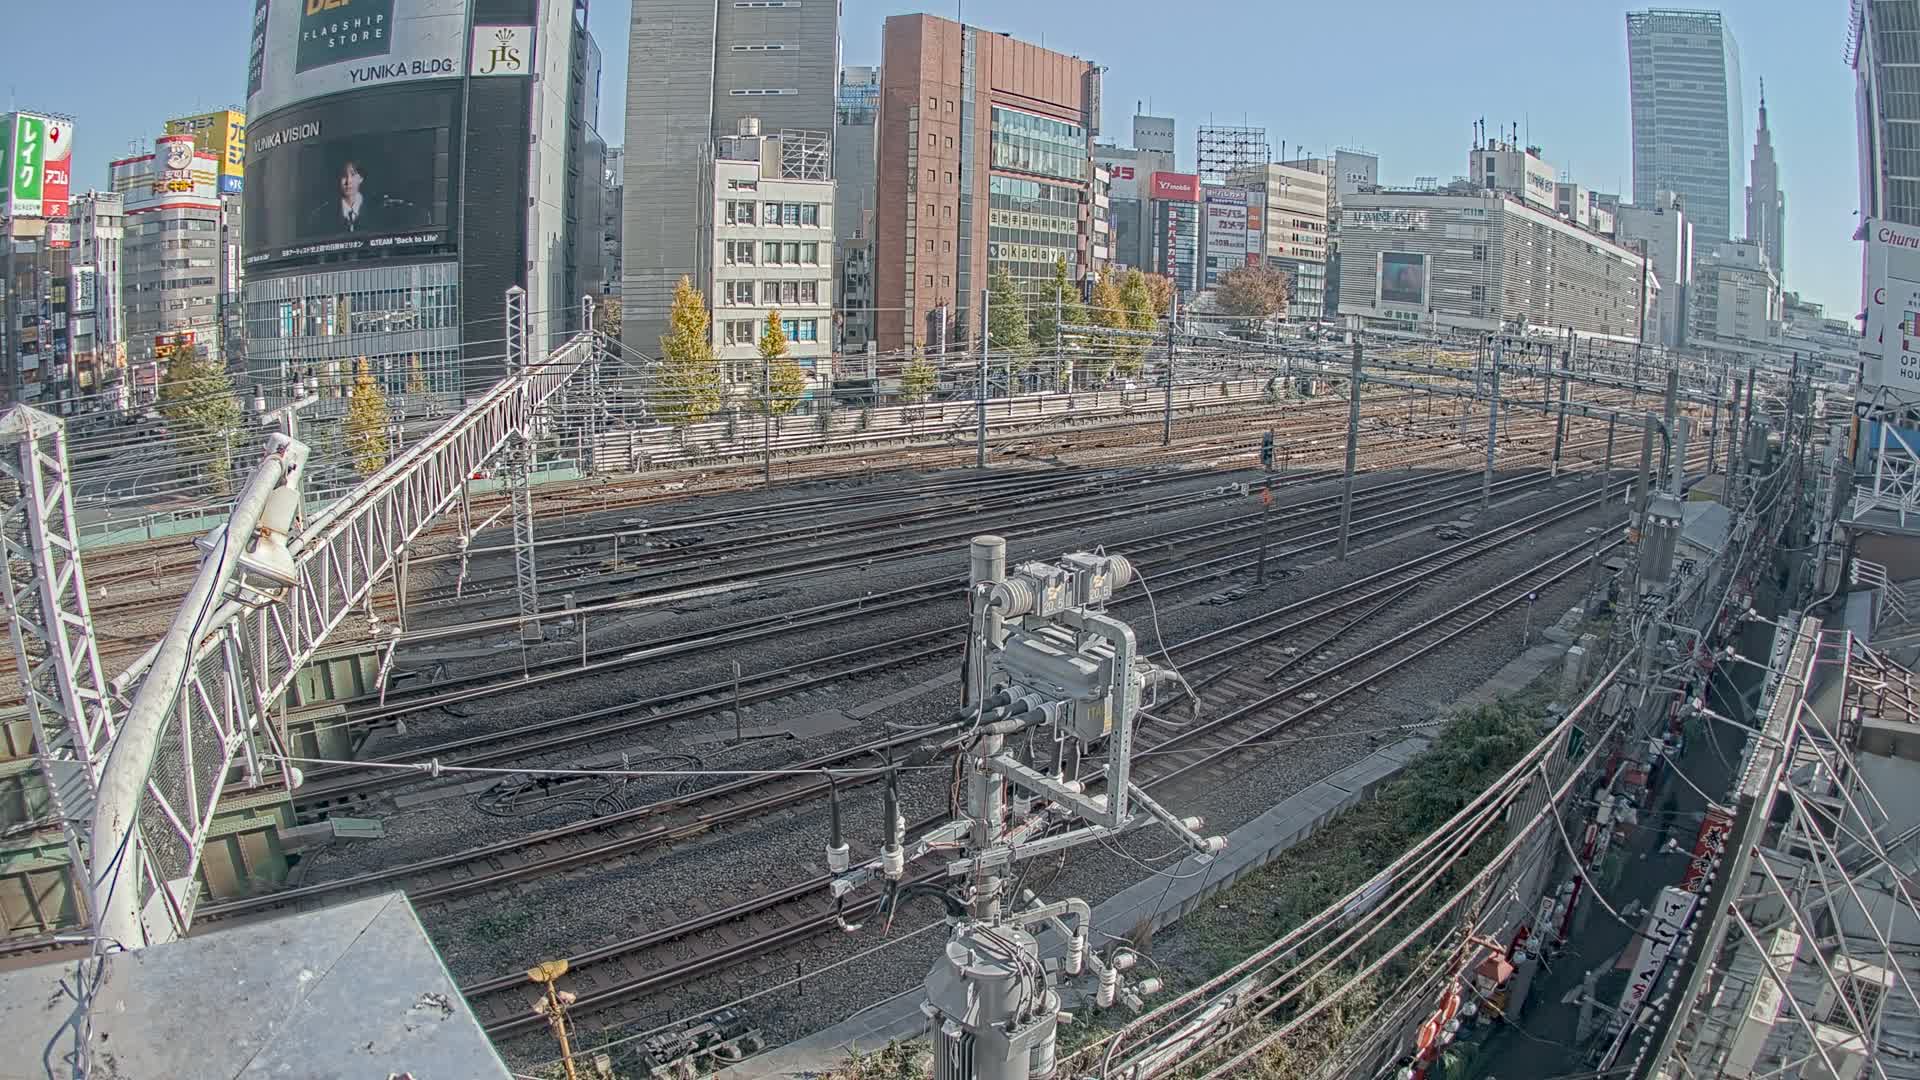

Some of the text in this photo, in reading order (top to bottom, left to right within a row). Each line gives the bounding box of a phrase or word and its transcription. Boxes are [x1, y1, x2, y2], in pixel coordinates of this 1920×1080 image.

[303, 14, 384, 41] FLAGSHIP
[328, 28, 382, 48] STORE
[350, 58, 456, 83] YUNIKA BLDG.
[254, 121, 320, 153] YUNIKA VISION
[1135, 129, 1174, 138] TAKANO
[20, 120, 37, 188] レイク
[45, 169, 68, 185] アコム
[1209, 207, 1246, 219] ヨドバシ
[1218, 220, 1246, 230] カメラ
[1167, 209, 1177, 278] ヨドバシカメラ
[1878, 227, 1920, 249] Churu
[1000, 245, 1067, 259] okadaya
[1901, 355, 1920, 369] OP
